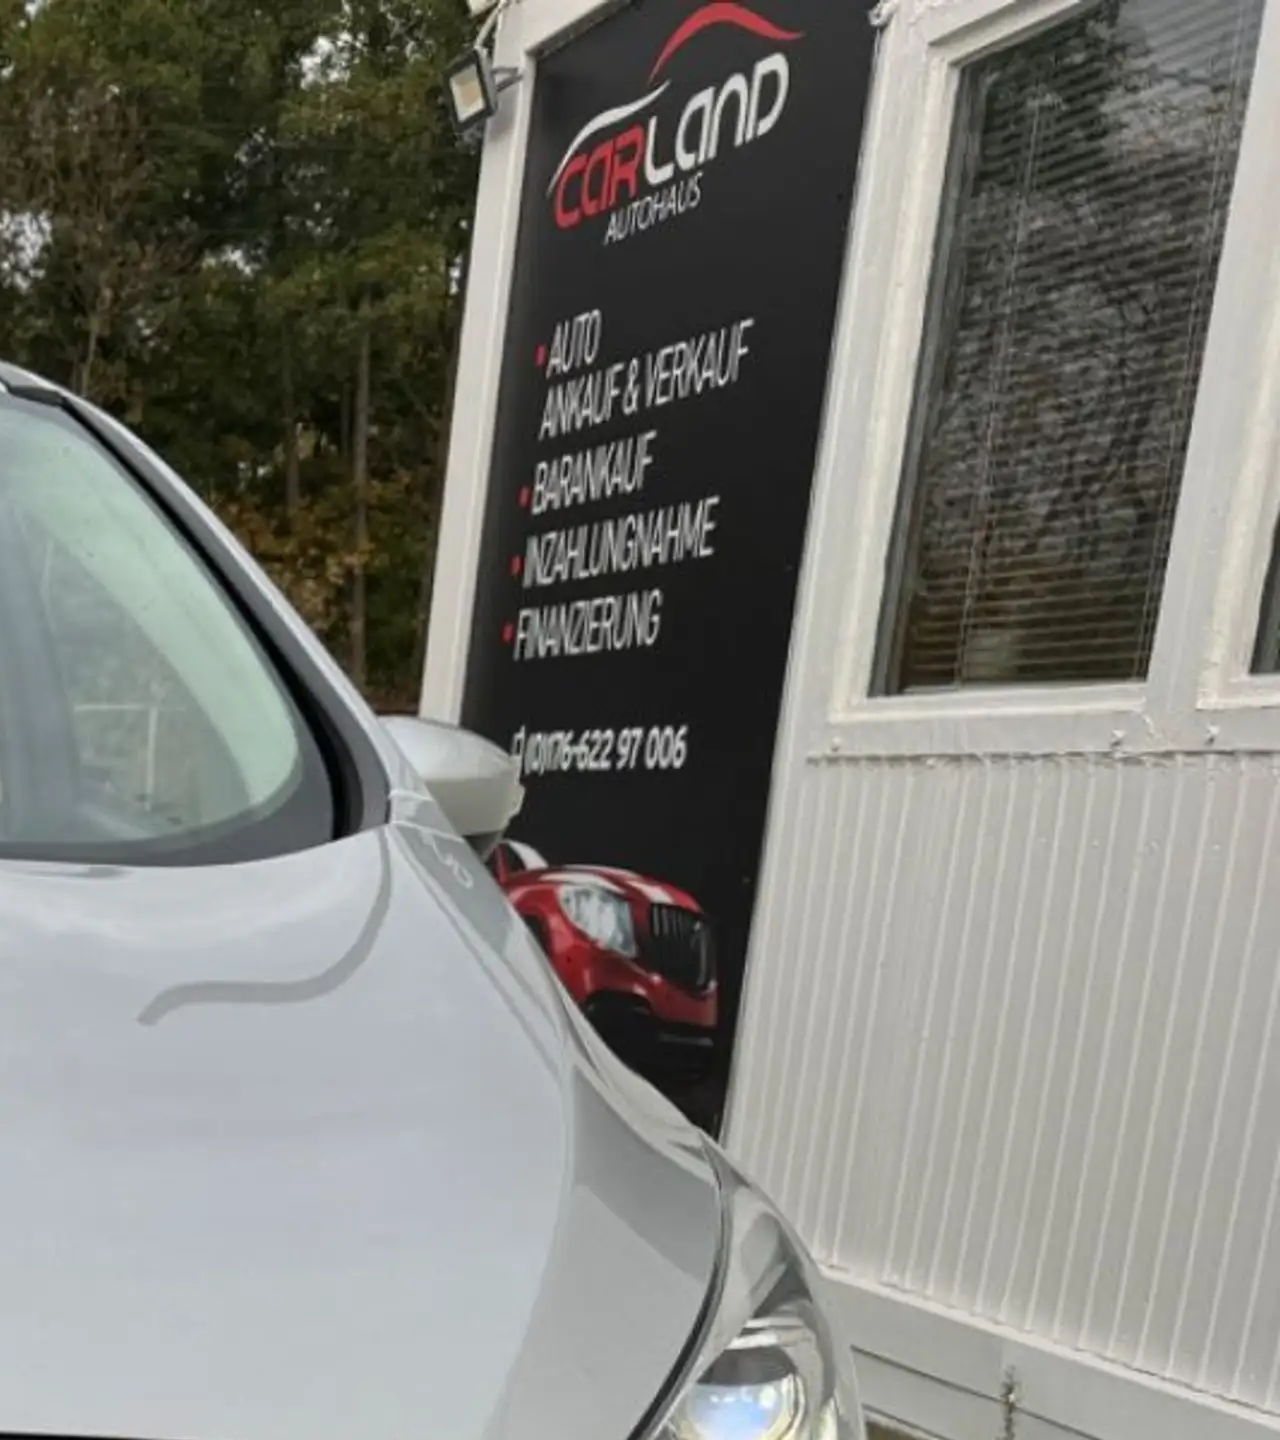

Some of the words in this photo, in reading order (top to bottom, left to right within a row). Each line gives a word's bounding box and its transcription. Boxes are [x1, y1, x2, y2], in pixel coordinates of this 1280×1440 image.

[603, 172, 703, 245] AUTOHAUS
[539, 363, 623, 440] ANKAUF
[623, 358, 639, 415] &
[644, 319, 755, 407] VERKAUF
[546, 309, 602, 379] AUTO
[531, 431, 658, 515] BARANKAUF
[522, 495, 720, 587] INZAHLUNGNAHME
[514, 589, 663, 661] FINANZIERUNG
[616, 726, 643, 770] 97
[645, 725, 688, 770] 006
